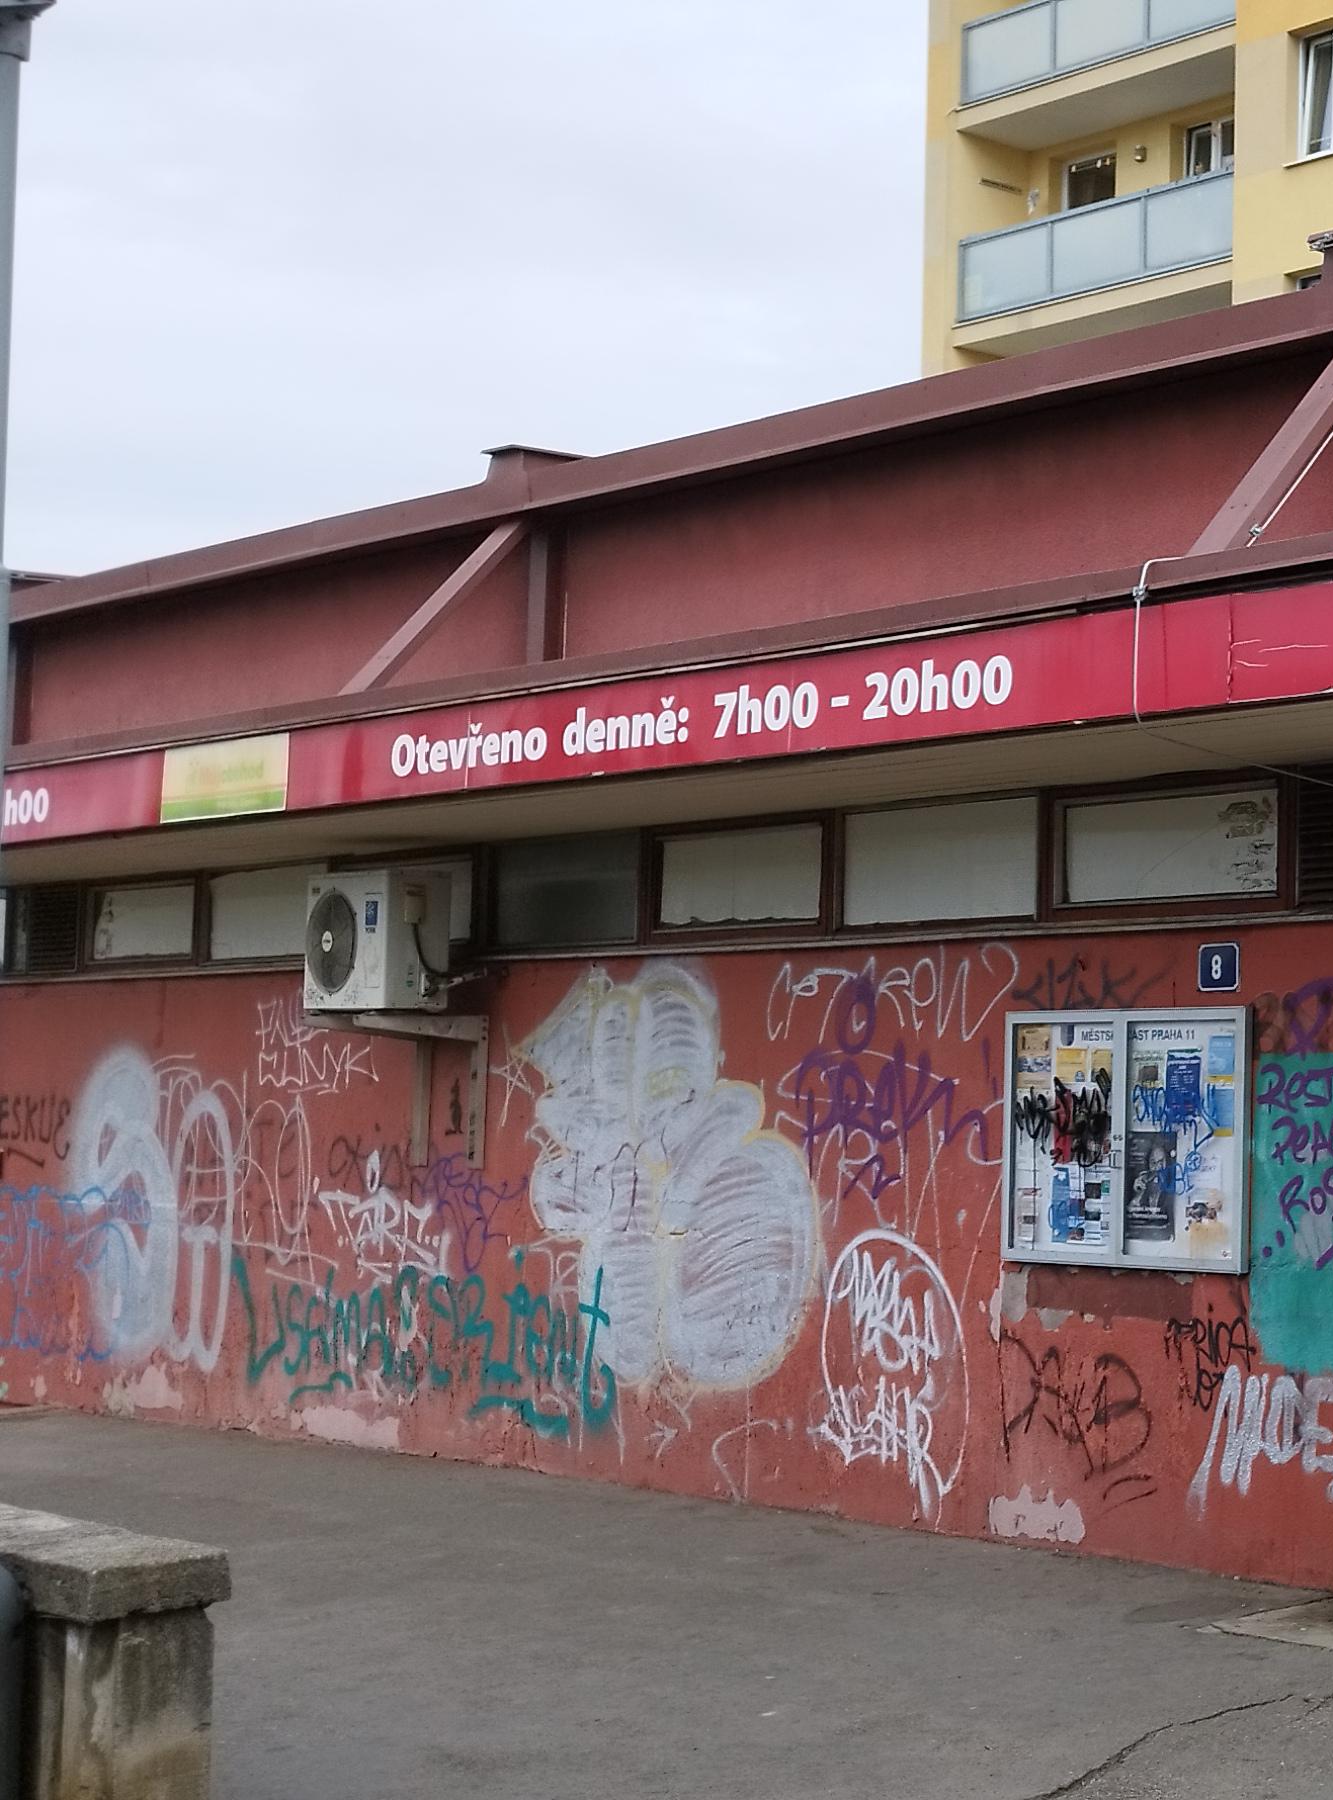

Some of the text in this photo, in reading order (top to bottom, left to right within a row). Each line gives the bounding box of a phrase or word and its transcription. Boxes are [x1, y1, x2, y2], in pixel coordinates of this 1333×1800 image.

[391, 655, 1014, 778] Otevřeno denně: 7h00 - 20h00
[1211, 954, 1222, 980] 8
[1151, 1029, 1183, 1041] PRAHA
[1185, 1028, 1195, 1040] 11
